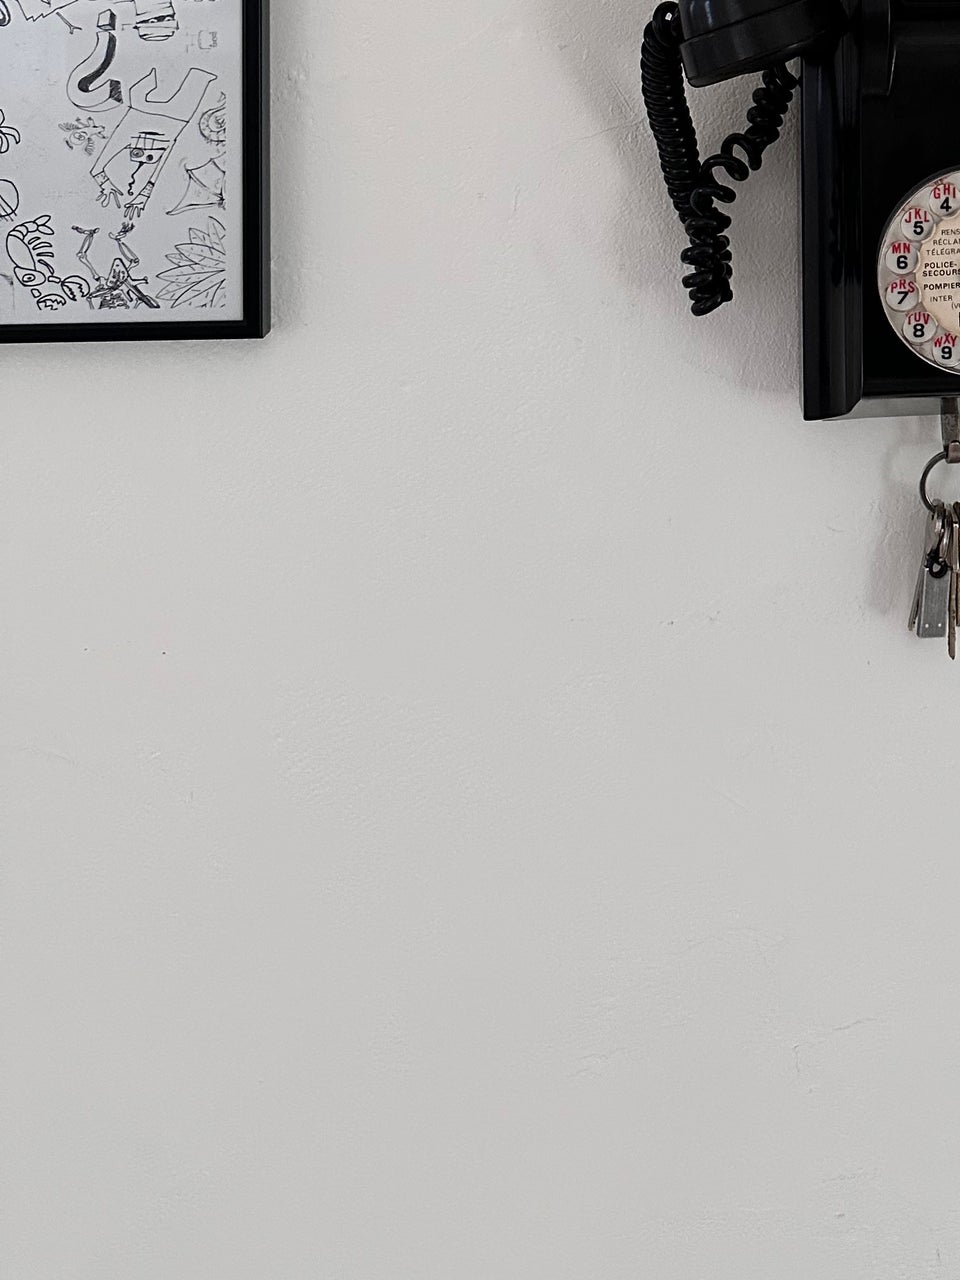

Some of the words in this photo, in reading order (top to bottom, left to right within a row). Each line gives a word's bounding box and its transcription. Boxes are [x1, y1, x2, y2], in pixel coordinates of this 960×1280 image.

[933, 182, 956, 199] GHI
[940, 196, 952, 212] 4
[904, 207, 930, 223] JKL
[913, 221, 924, 236] 5
[891, 242, 911, 255] MN
[896, 255, 909, 270] 6
[924, 260, 958, 270] POLICE-
[890, 279, 916, 294] PRS
[897, 291, 909, 305] 7
[929, 294, 953, 303] INTER
[906, 311, 931, 325] TUV
[913, 323, 925, 338] 8
[934, 333, 958, 348] WXY
[941, 346, 953, 360] 9
